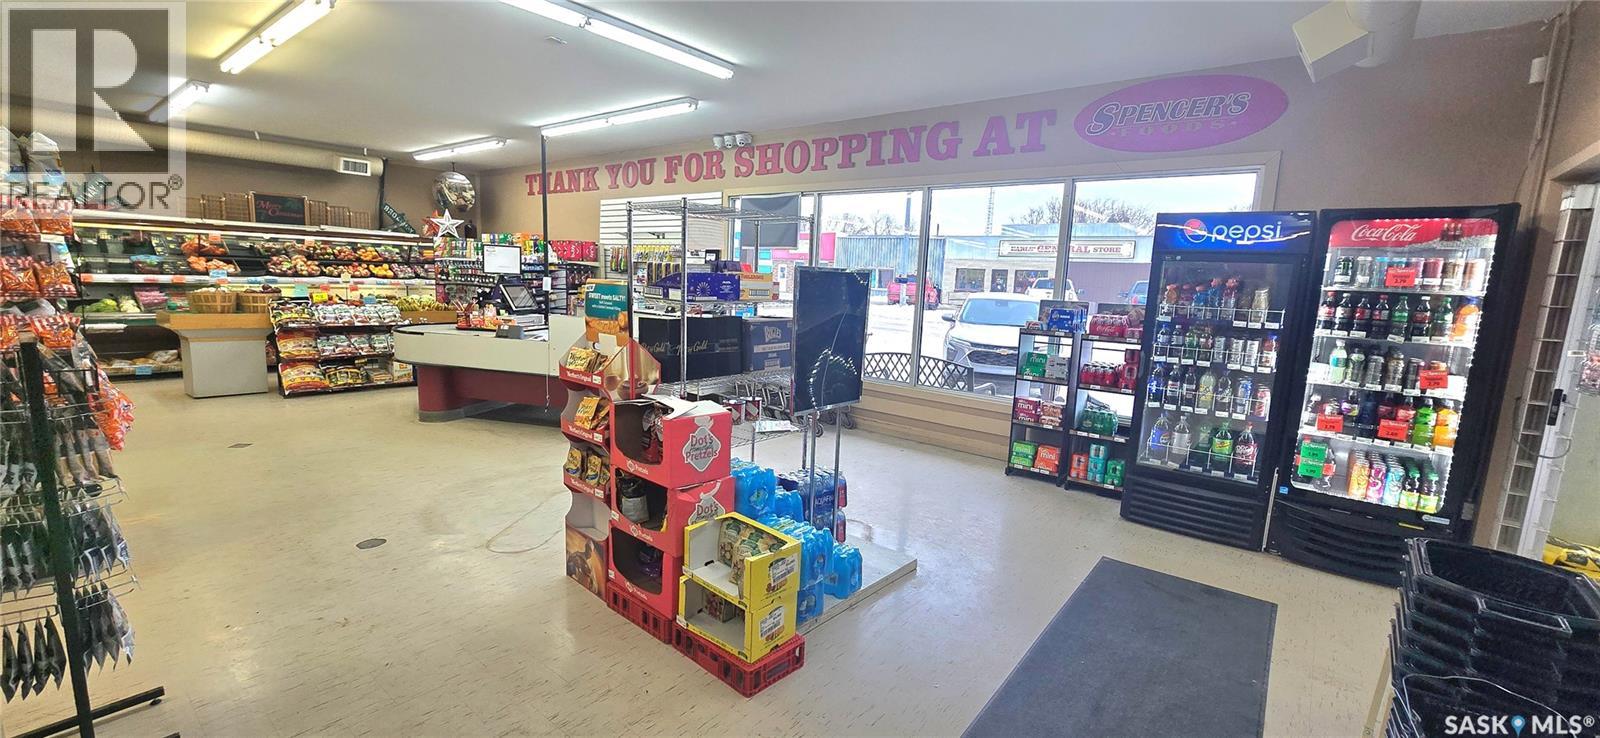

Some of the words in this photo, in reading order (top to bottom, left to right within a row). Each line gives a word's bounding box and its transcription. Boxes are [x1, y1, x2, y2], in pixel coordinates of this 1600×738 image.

[1085, 92, 1252, 136] SPENCER'S
[1120, 120, 1226, 138] FOODS
[524, 167, 600, 196] THANK
[606, 158, 656, 188] YOU
[664, 150, 724, 184] FOR
[734, 120, 964, 179] SHOPPING
[972, 109, 1057, 157] AT
[1211, 221, 1283, 243] pepsi
[1351, 223, 1423, 242] Coca-Cola
[1037, 243, 1091, 254] GENRAL
[1017, 402, 1033, 410] mini
[690, 433, 714, 447] Dot's
[685, 448, 718, 461] Pretzels
[696, 501, 719, 516] Dot's
